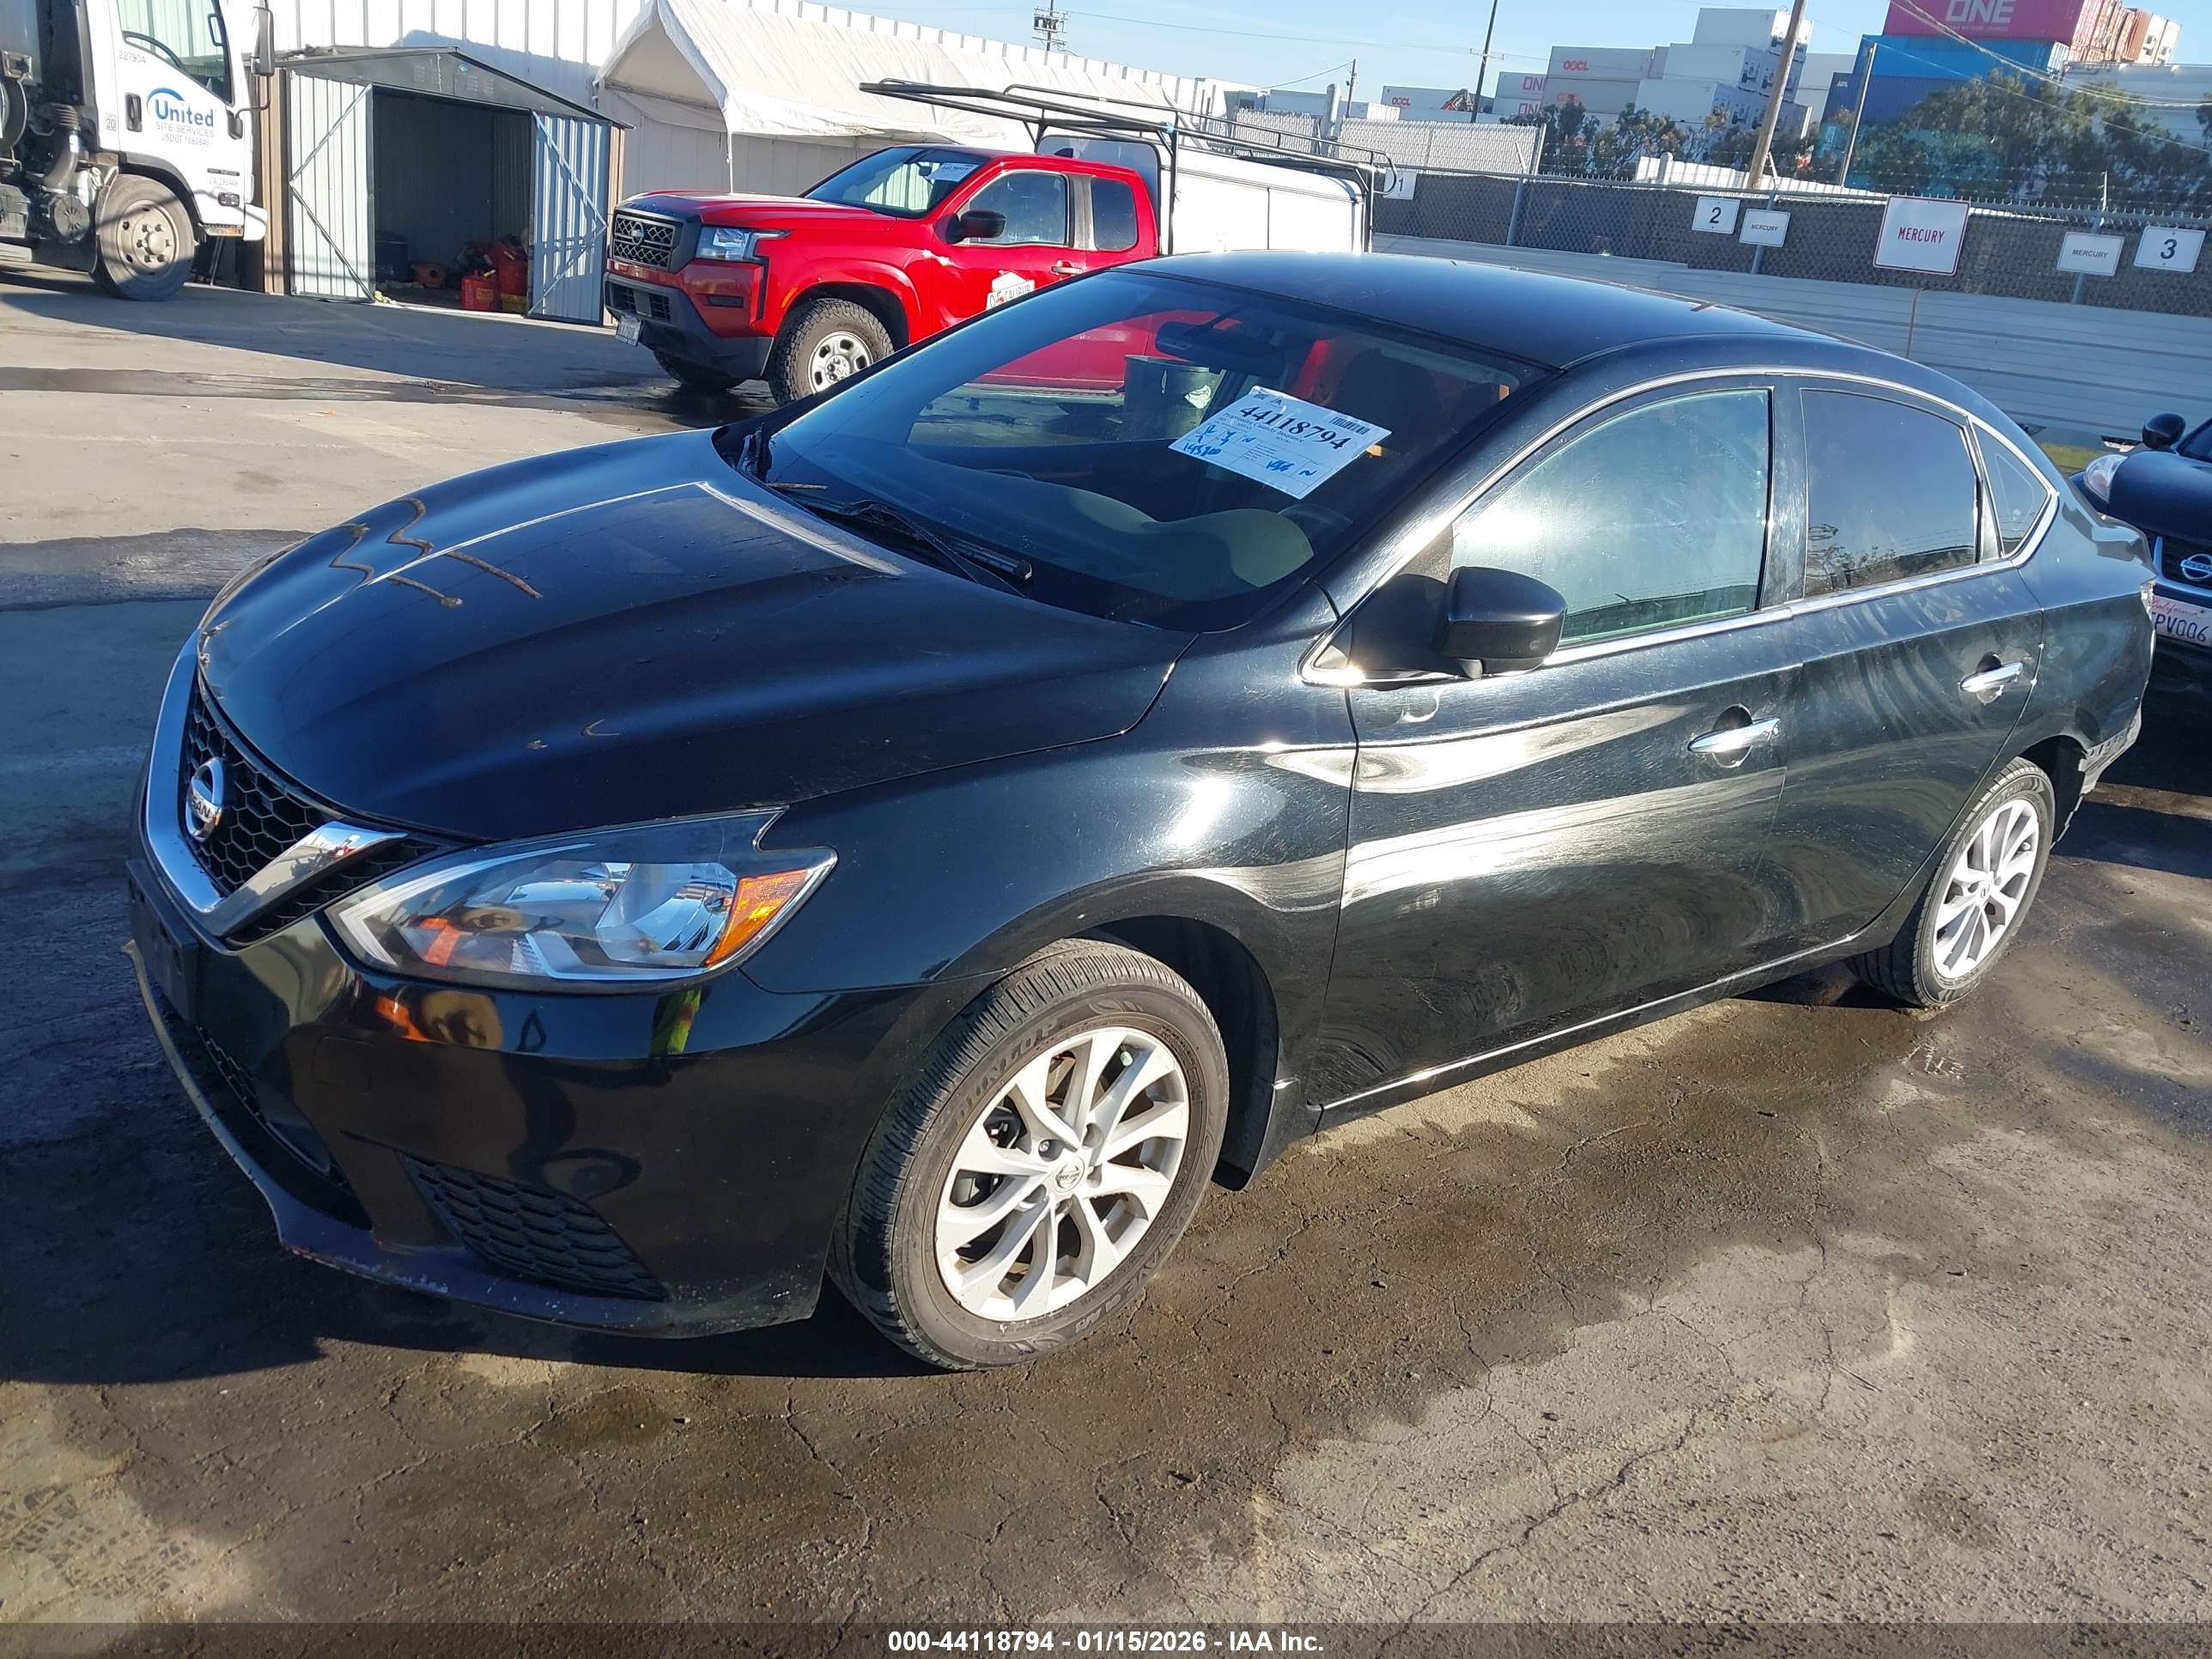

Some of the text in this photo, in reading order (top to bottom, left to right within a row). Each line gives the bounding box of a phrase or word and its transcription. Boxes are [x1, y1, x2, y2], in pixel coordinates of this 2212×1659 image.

[1563, 61, 1589, 70] OOCL
[1391, 96, 1411, 106] OOCL
[155, 99, 214, 127] United
[155, 121, 215, 138] SITE SERVICES
[1399, 177, 1404, 192] 1
[1709, 206, 1722, 224] 2
[1751, 223, 1779, 232] MERCURY
[1897, 227, 1945, 244] MERCURY
[2072, 249, 2109, 258] MERCURY
[2160, 239, 2178, 259] 3
[1240, 406, 1352, 449] 44118794
[2152, 612, 2209, 642] PV006
[952, 1019, 1060, 1127] DUNLOP
